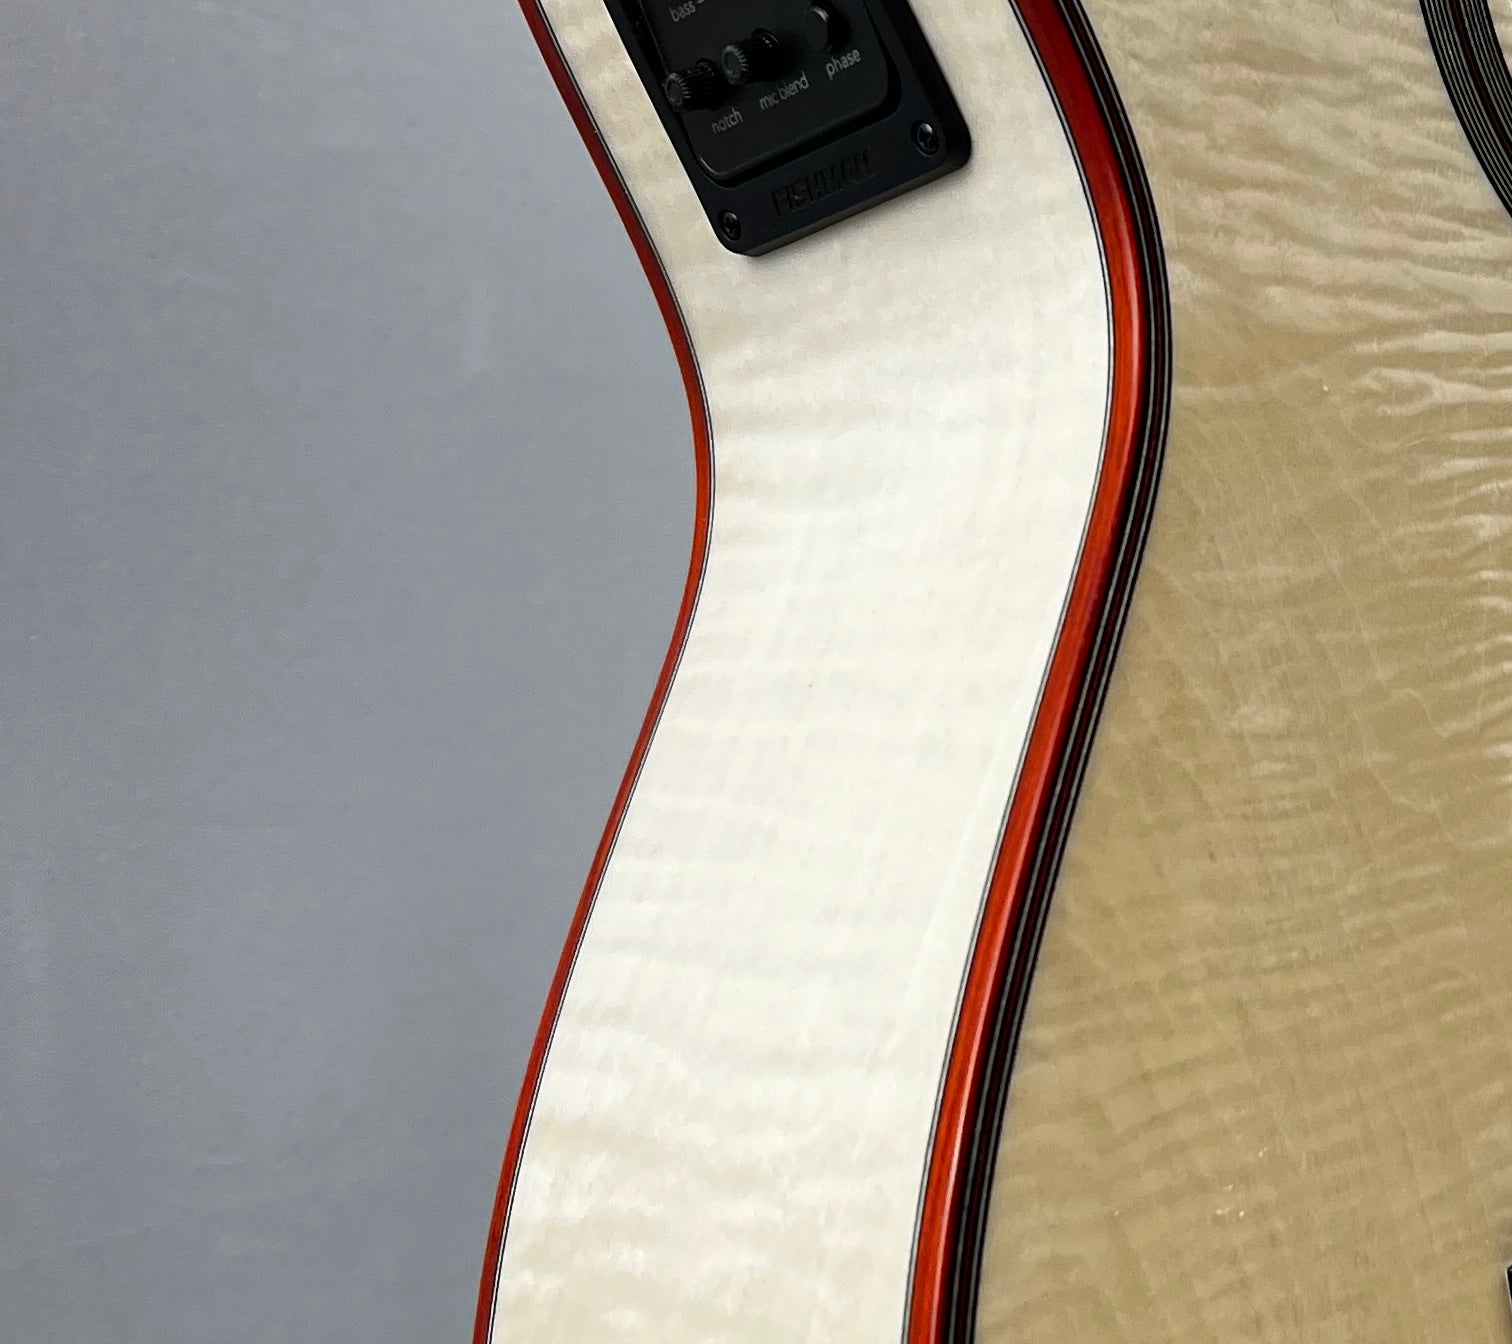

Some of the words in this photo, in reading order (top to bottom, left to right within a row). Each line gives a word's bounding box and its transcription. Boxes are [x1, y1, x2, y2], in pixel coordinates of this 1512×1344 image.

[668, 0, 697, 23] bass
[825, 49, 862, 81] phase
[758, 92, 780, 111] mic
[777, 71, 811, 101] blend
[711, 107, 744, 135] notch
